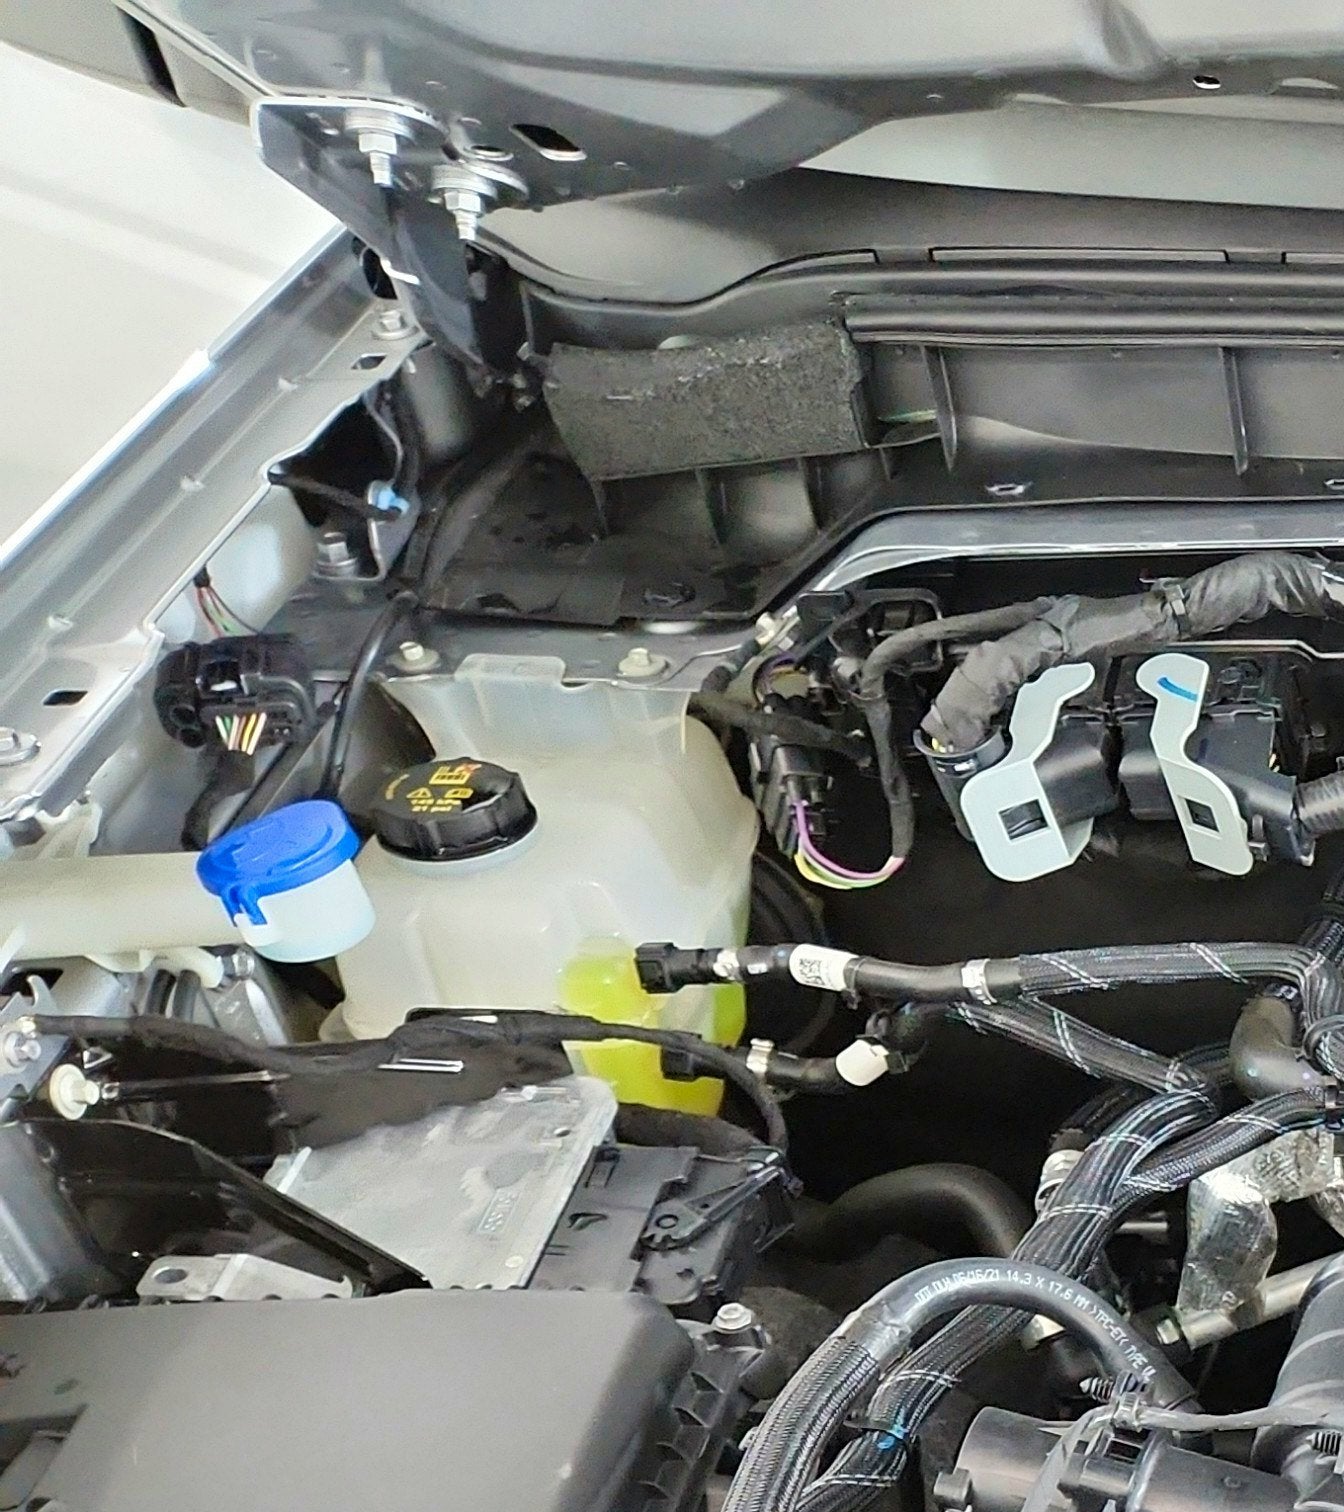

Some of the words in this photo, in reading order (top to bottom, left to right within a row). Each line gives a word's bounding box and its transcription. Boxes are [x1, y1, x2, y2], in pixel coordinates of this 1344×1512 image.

[1006, 1269, 1031, 1285] 14.3
[1035, 1276, 1045, 1288] X
[1049, 1280, 1073, 1301] 17.6
